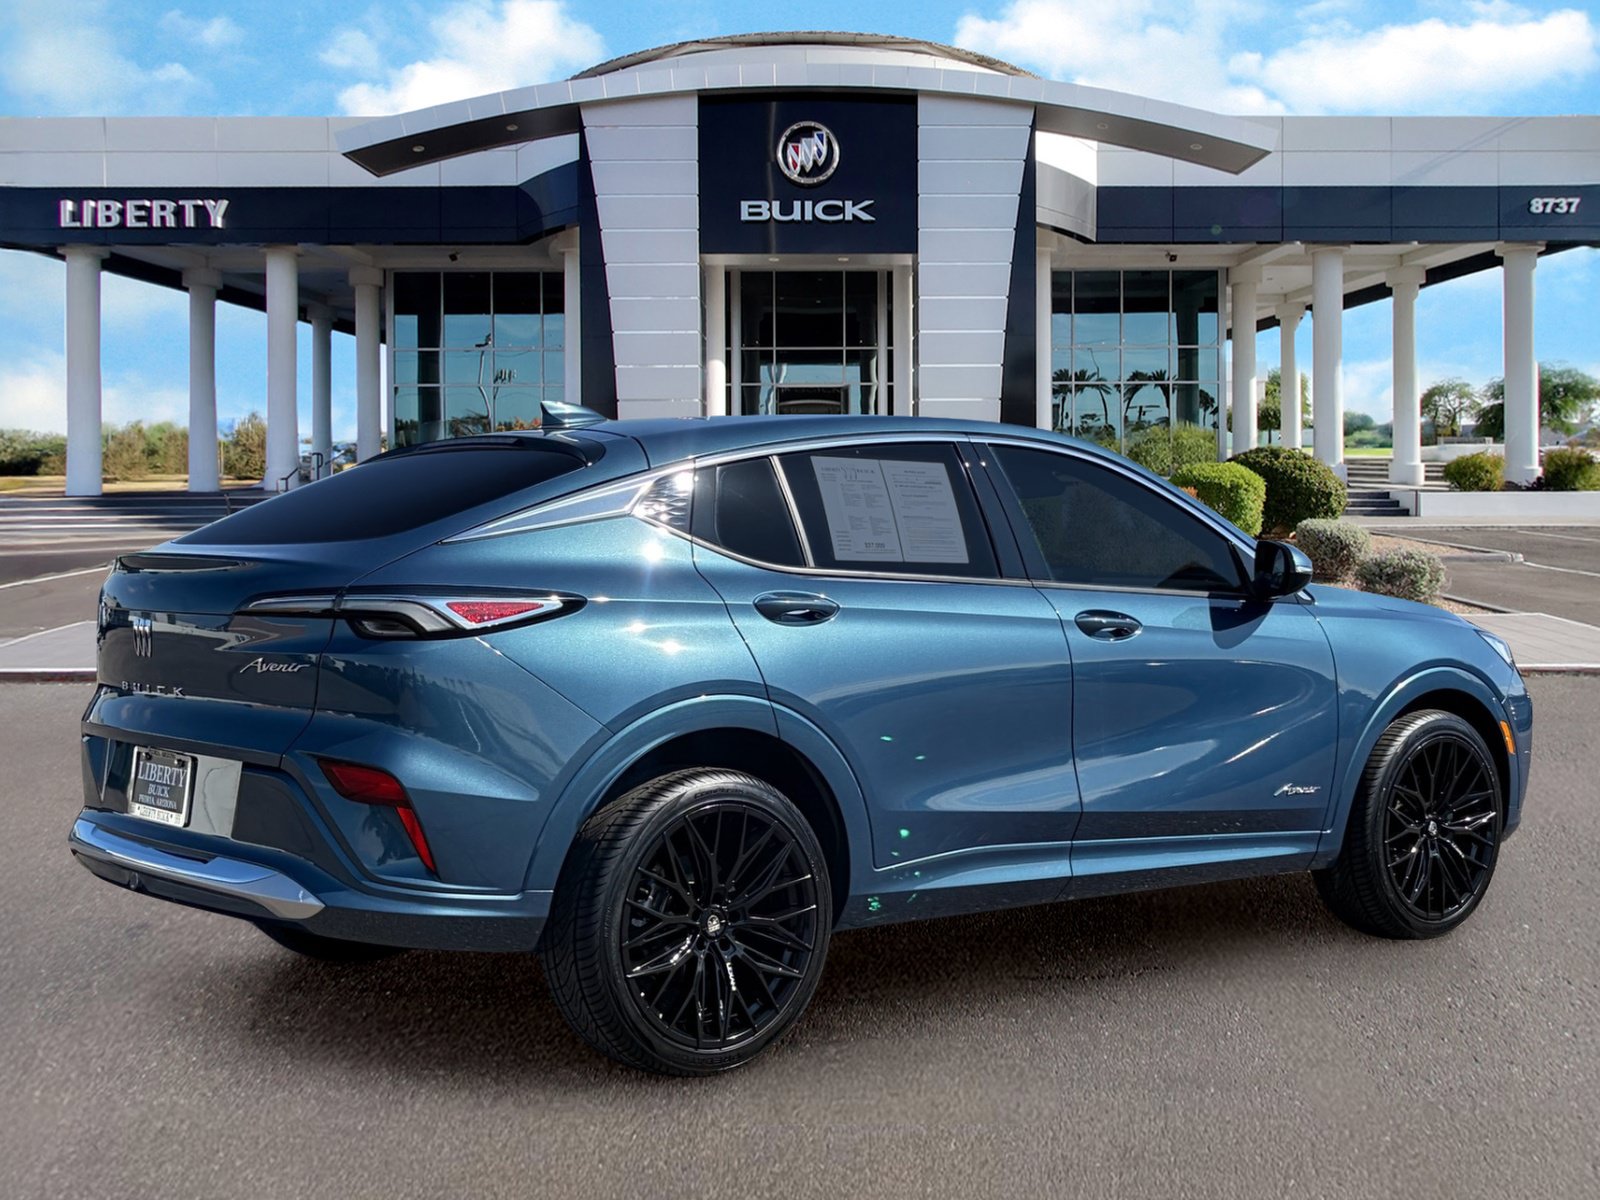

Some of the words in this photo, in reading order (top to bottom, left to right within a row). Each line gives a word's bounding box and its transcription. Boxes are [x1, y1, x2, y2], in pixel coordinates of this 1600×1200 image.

[59, 199, 230, 228] LIBERTY
[740, 200, 876, 222] BUICK
[1529, 197, 1581, 214] 8737
[239, 656, 310, 674] Avenir
[137, 761, 188, 788] LIBERTY
[148, 783, 170, 798] BUICK
